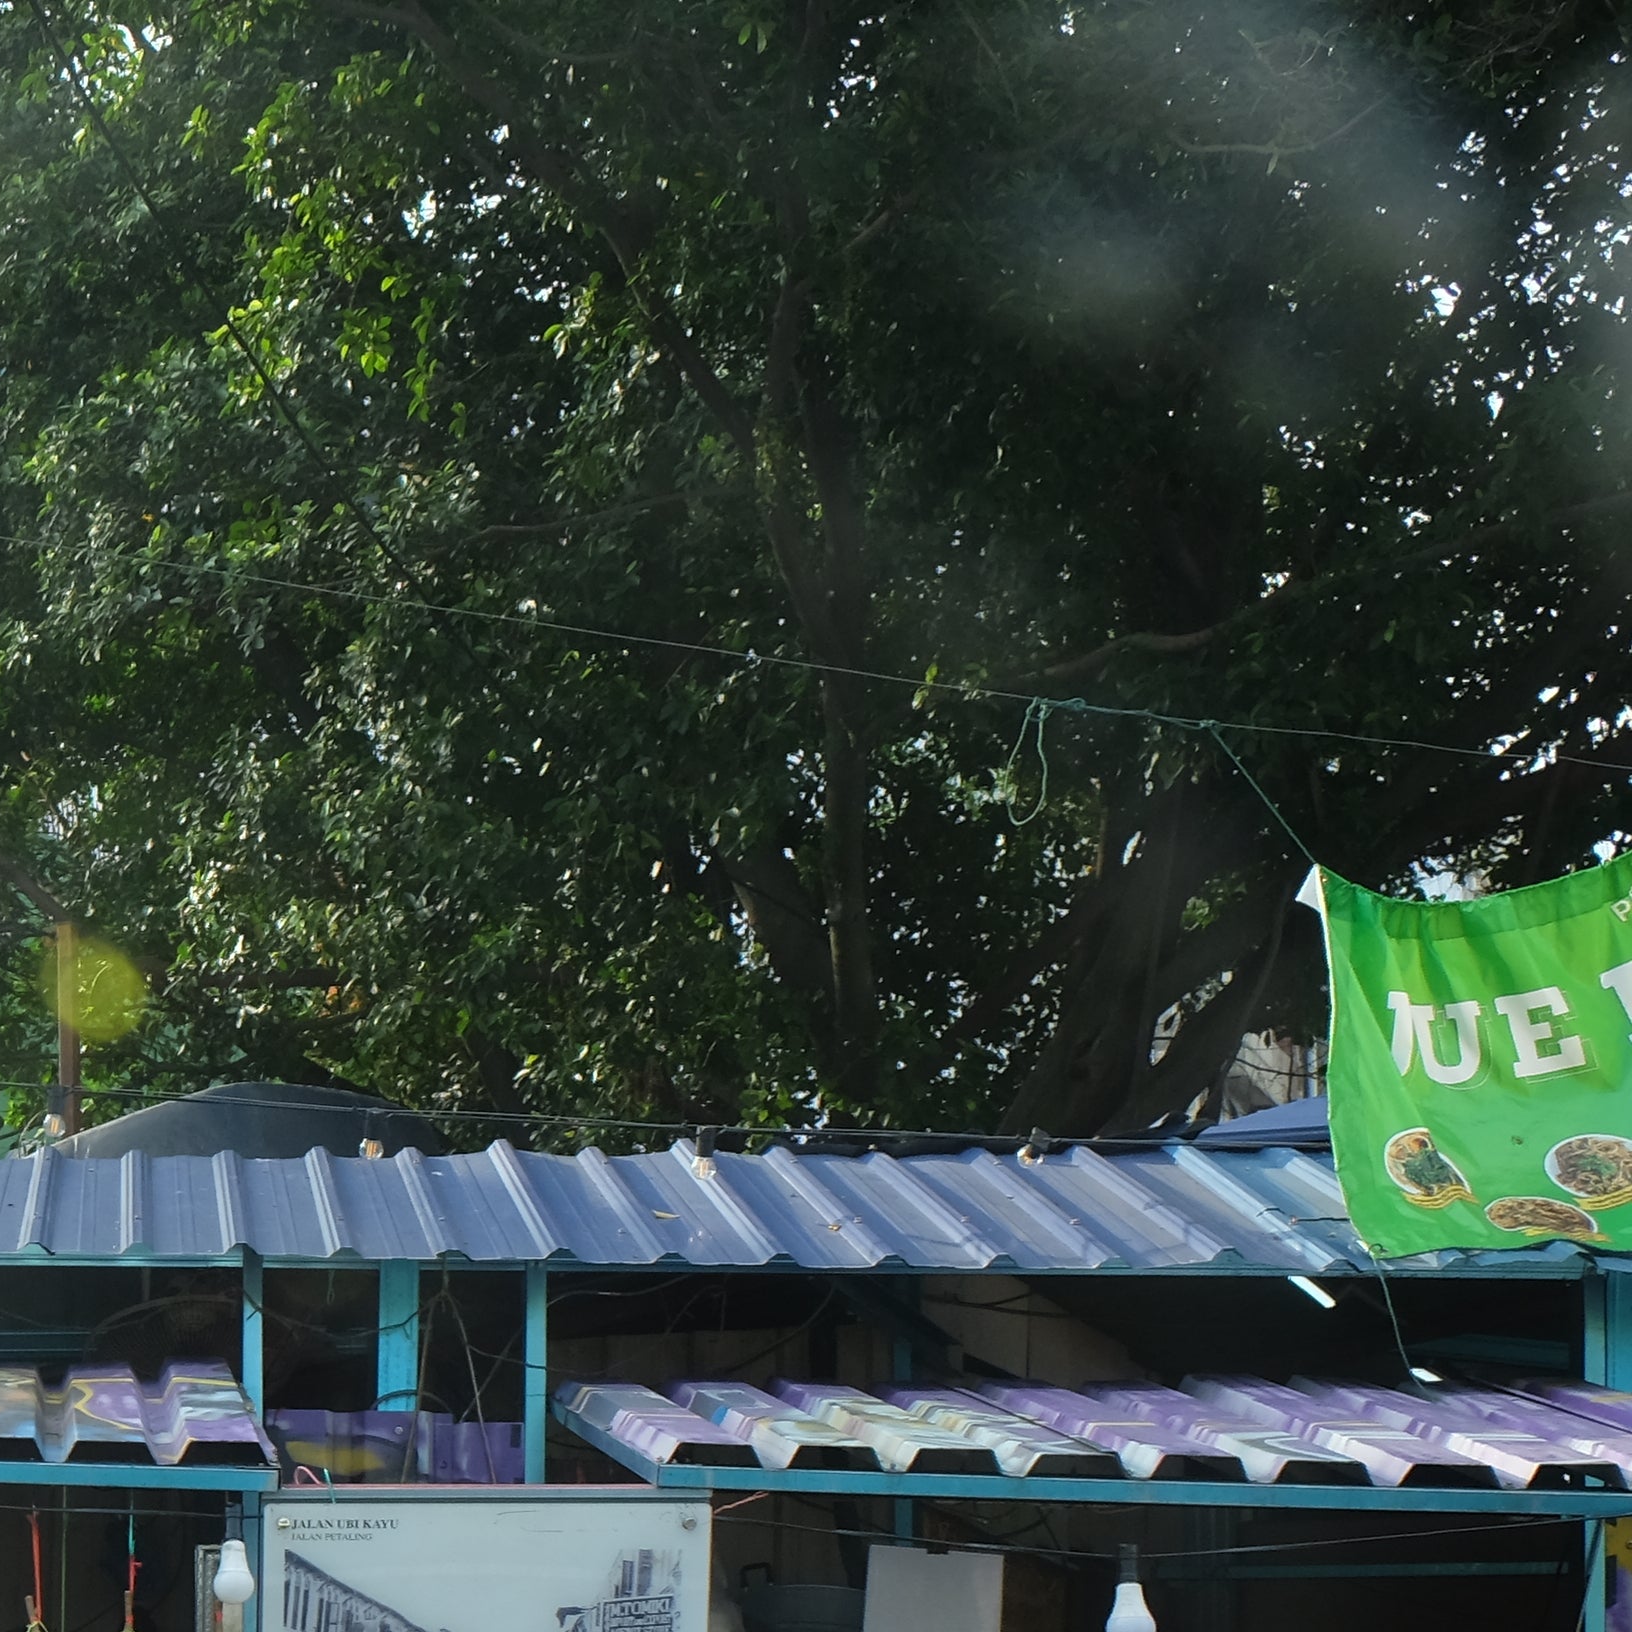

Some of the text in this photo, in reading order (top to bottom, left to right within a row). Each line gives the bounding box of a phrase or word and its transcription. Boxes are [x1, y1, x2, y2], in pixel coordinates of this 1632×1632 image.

[292, 1519, 399, 1529] JALAN UBI KAYU
